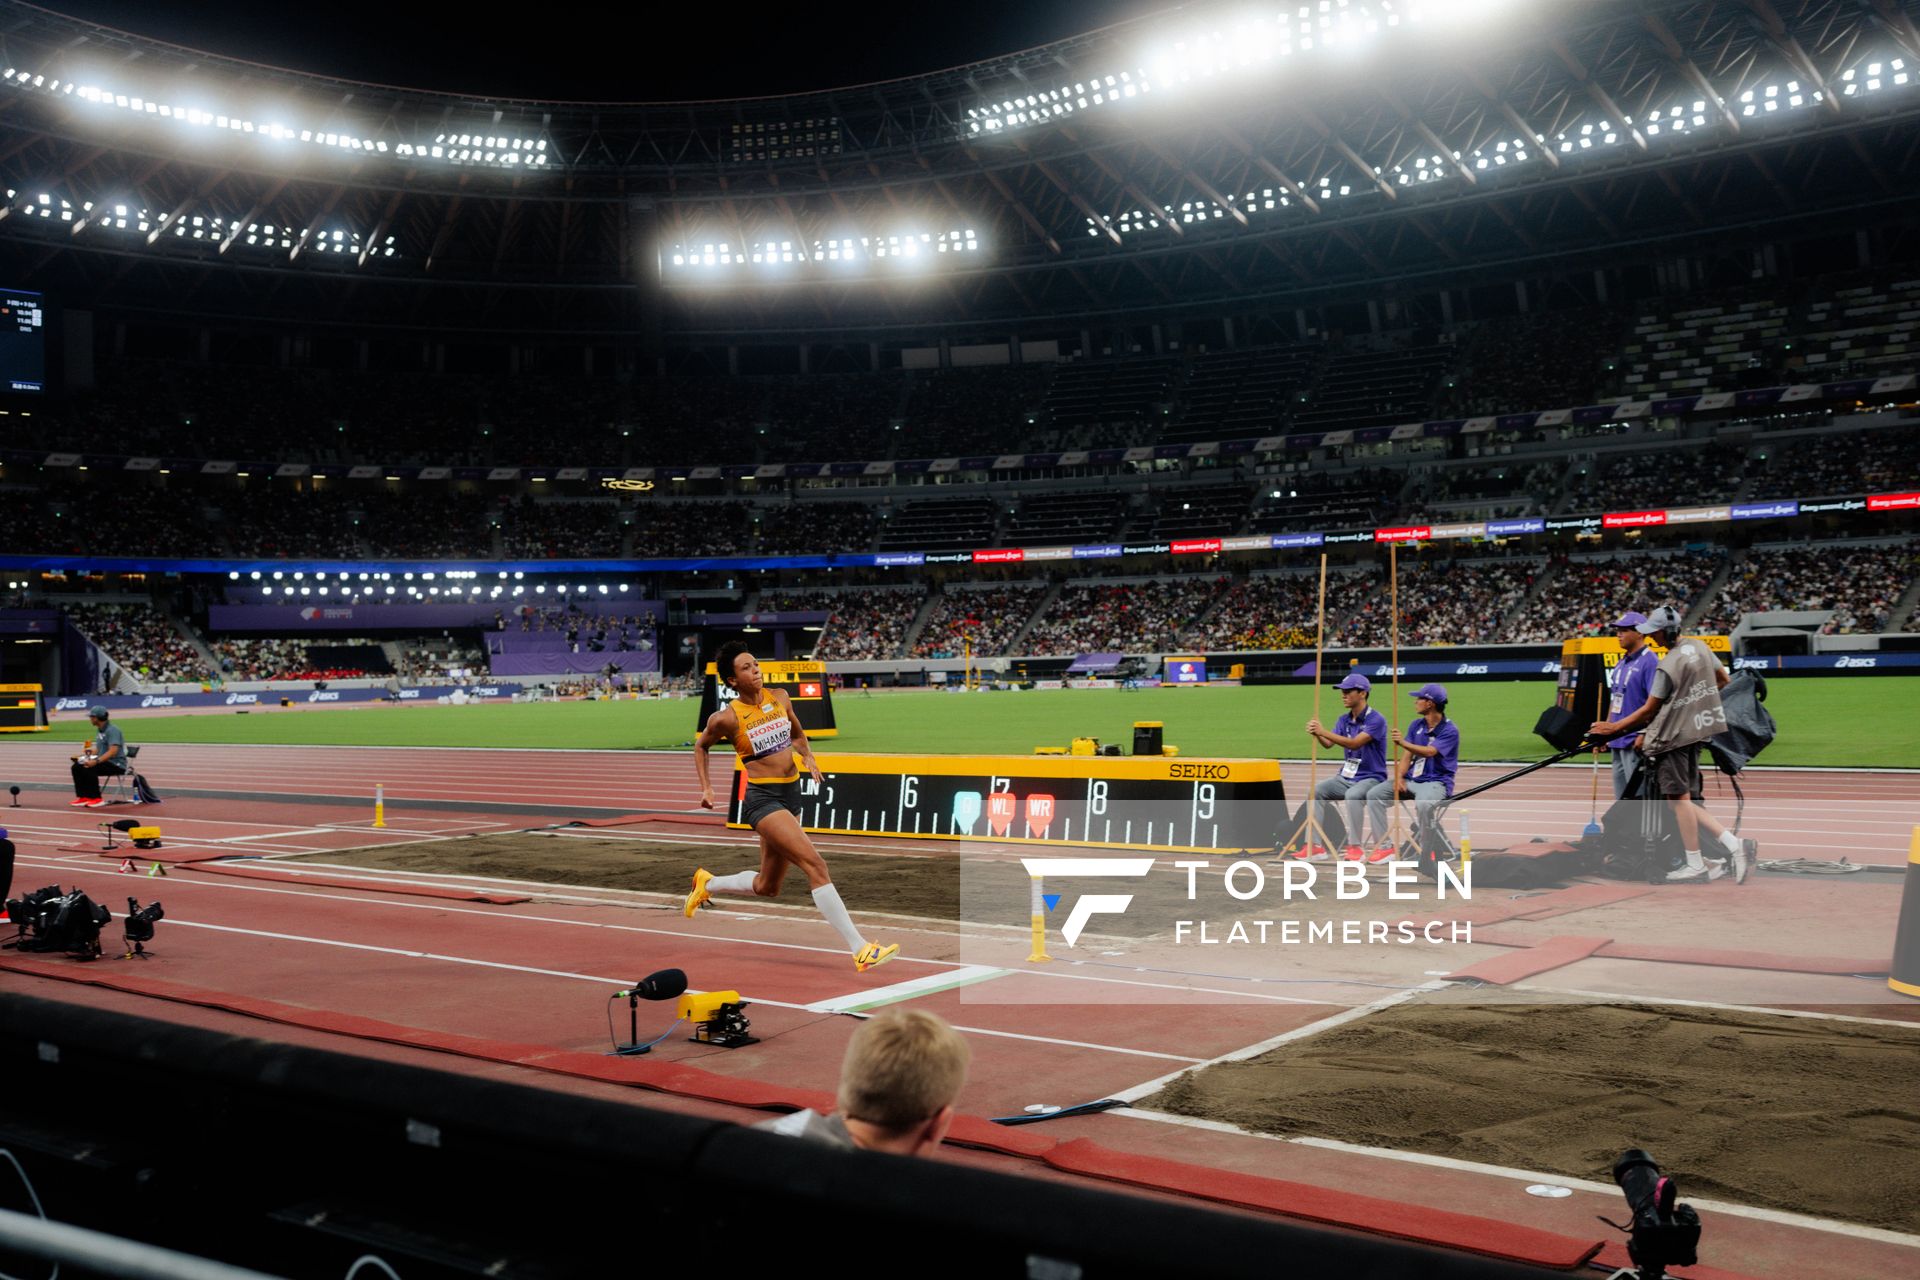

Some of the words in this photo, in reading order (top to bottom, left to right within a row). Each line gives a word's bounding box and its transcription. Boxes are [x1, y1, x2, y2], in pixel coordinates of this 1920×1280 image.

[781, 663, 818, 672] SEIKO
[749, 720, 788, 738] HONDA
[754, 728, 791, 751] MIHAMB
[1170, 764, 1230, 779] SEIKO
[904, 777, 919, 808] 6
[1092, 781, 1108, 815] 8
[1198, 784, 1215, 819] 9
[992, 798, 1011, 815] WL
[1030, 800, 1051, 816] WR
